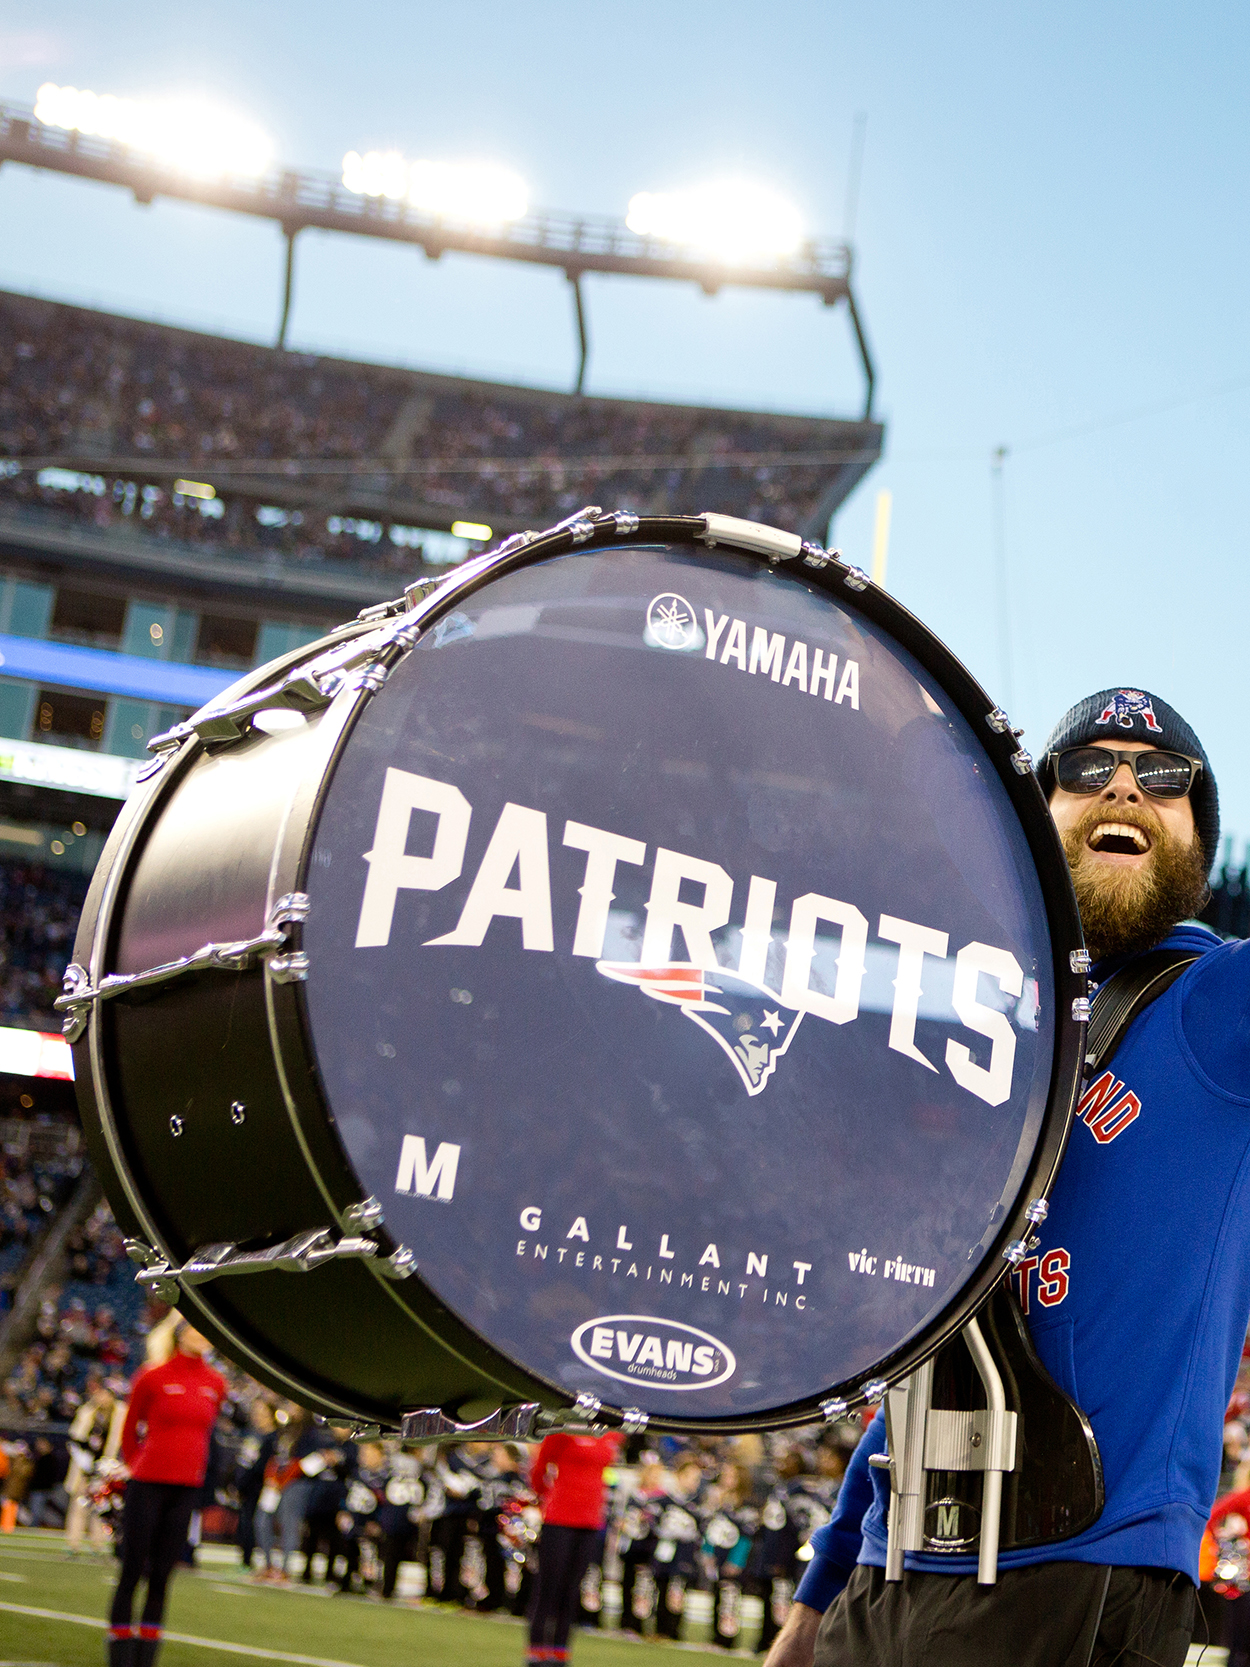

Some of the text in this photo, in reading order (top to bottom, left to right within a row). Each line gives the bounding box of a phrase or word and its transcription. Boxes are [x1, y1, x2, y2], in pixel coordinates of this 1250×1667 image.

[704, 608, 860, 711] YAMAHA
[354, 767, 1026, 1107] PATRIOTS
[395, 1133, 461, 1202] M
[516, 1240, 749, 1299] ENTERTAINMENT
[519, 1206, 812, 1286] GALLANT
[1003, 1247, 1071, 1315] TS
[589, 1327, 716, 1376] EVANS
[627, 1362, 678, 1381] drumheads
[937, 1505, 959, 1538] M
